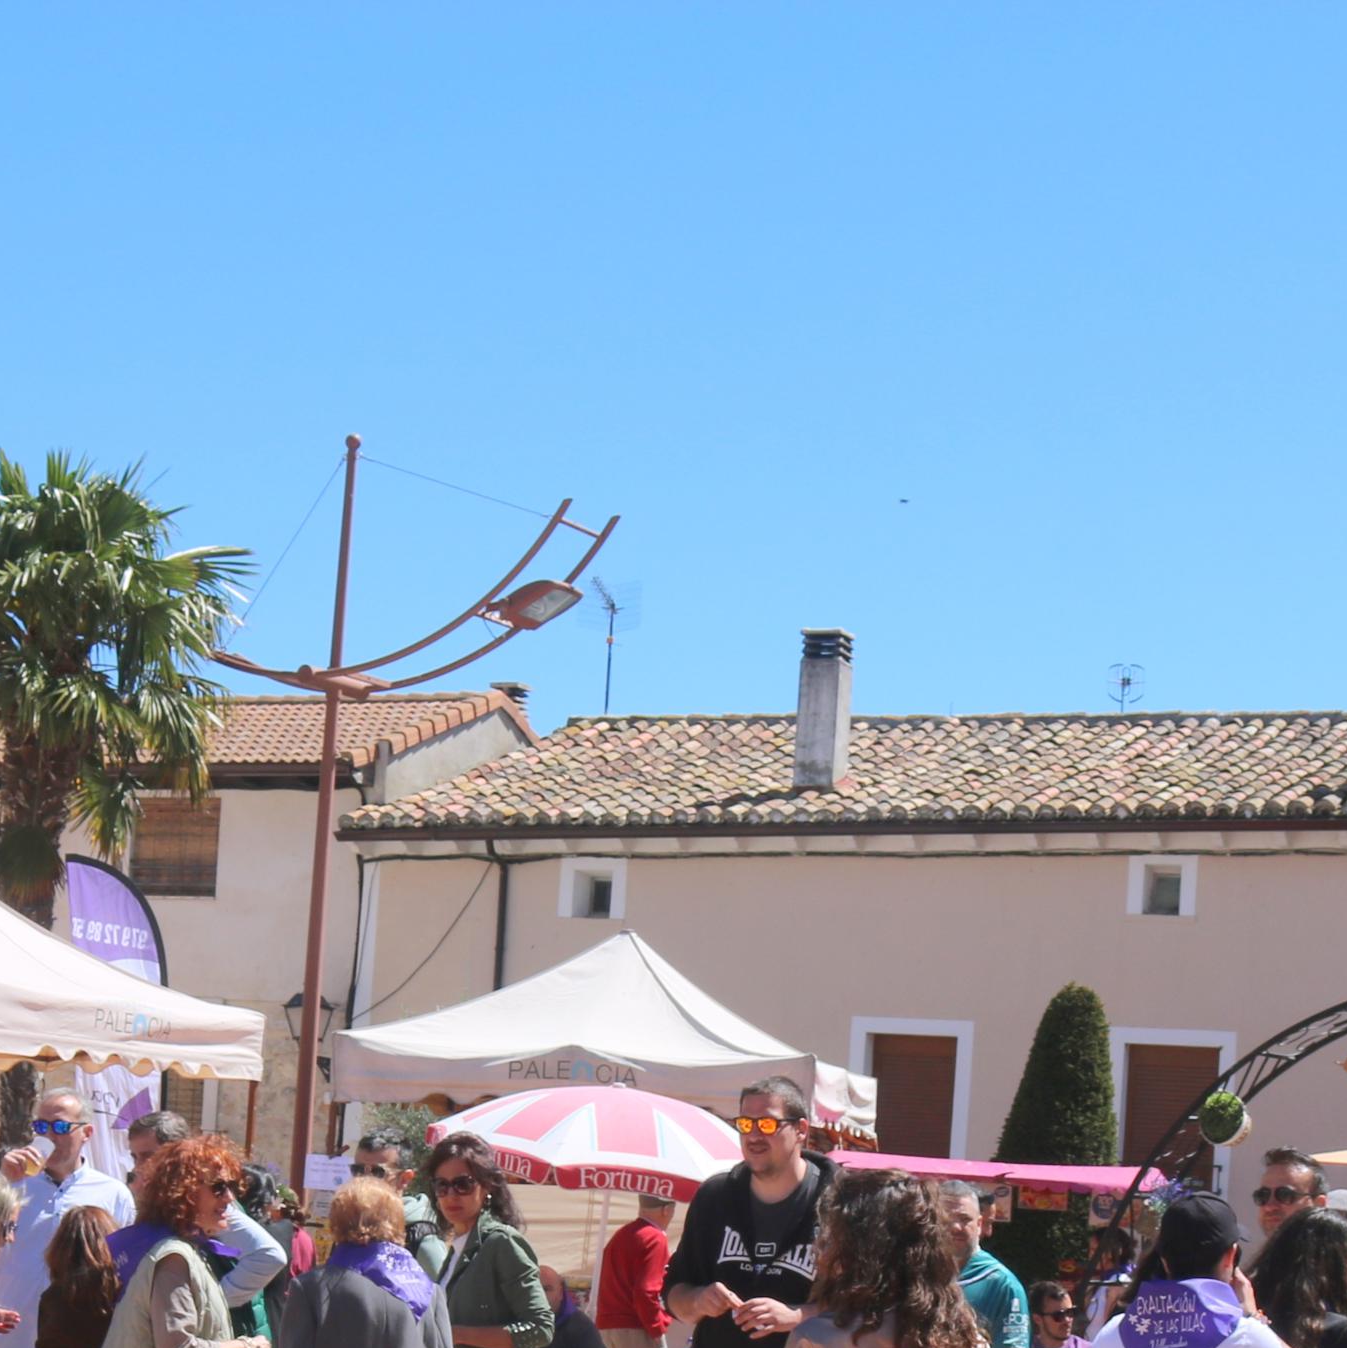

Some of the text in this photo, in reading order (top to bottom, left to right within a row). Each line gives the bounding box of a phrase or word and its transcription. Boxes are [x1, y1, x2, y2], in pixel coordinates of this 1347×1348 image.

[578, 1167, 674, 1198] Fortuna
[1153, 1311, 1207, 1335] DE LAS LILAS
